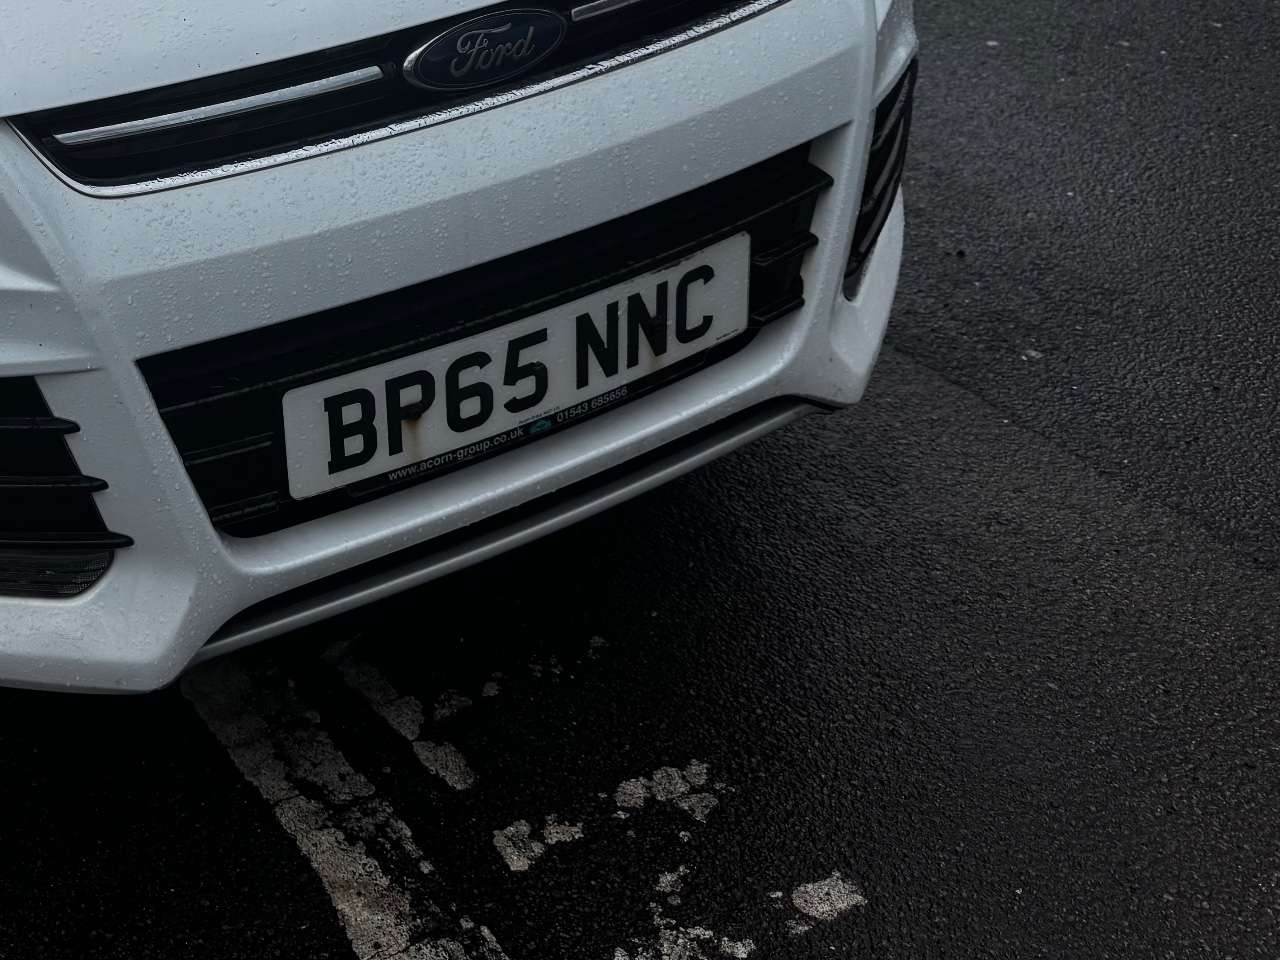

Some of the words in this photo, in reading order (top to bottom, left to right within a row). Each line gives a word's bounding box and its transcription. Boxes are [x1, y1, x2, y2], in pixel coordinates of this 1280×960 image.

[450, 22, 537, 78] Ford
[324, 327, 549, 475] BP65
[575, 264, 715, 390] NNC
[387, 426, 525, 482] www.acorn-group.co.uk
[556, 402, 589, 422] 01543
